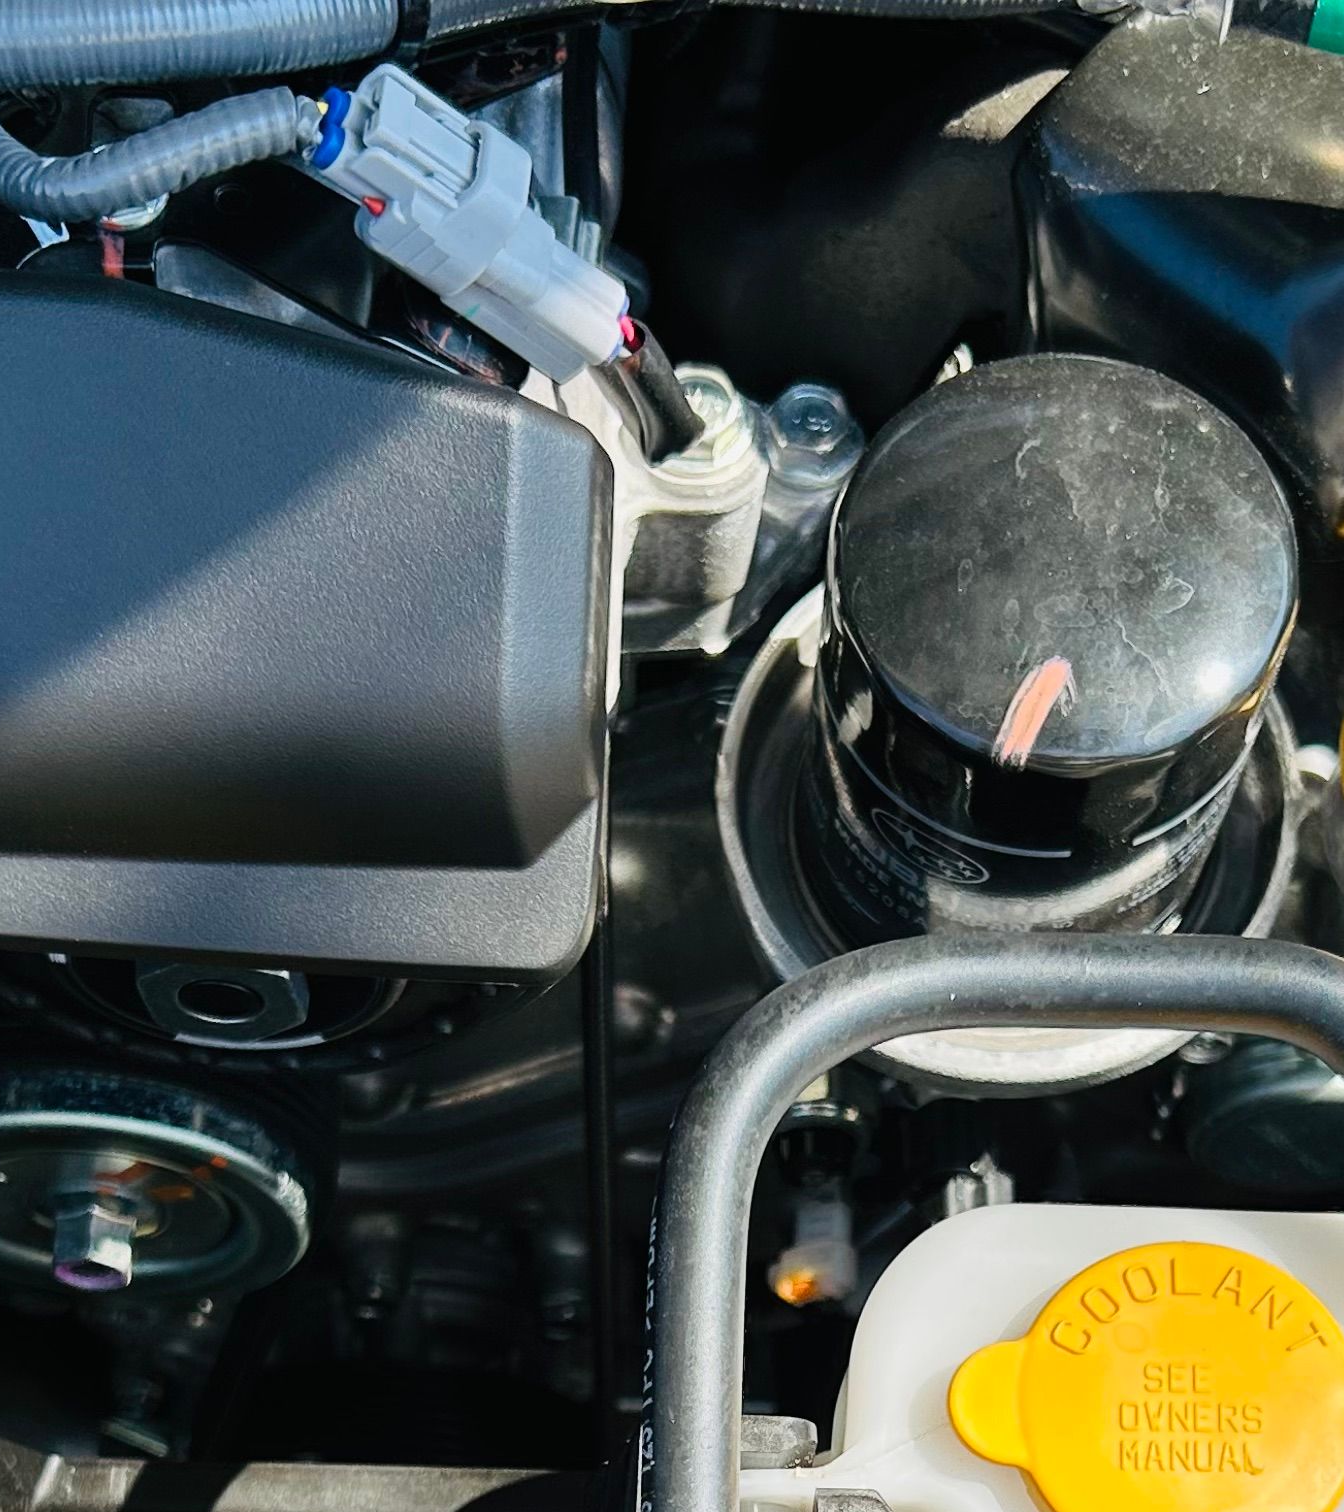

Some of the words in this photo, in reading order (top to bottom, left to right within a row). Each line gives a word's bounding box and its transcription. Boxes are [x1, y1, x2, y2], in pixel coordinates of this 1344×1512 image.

[1049, 1258, 1327, 1355] COOLANT
[1143, 1362, 1211, 1394] SEE
[1118, 1440, 1264, 1475] MANUAL
